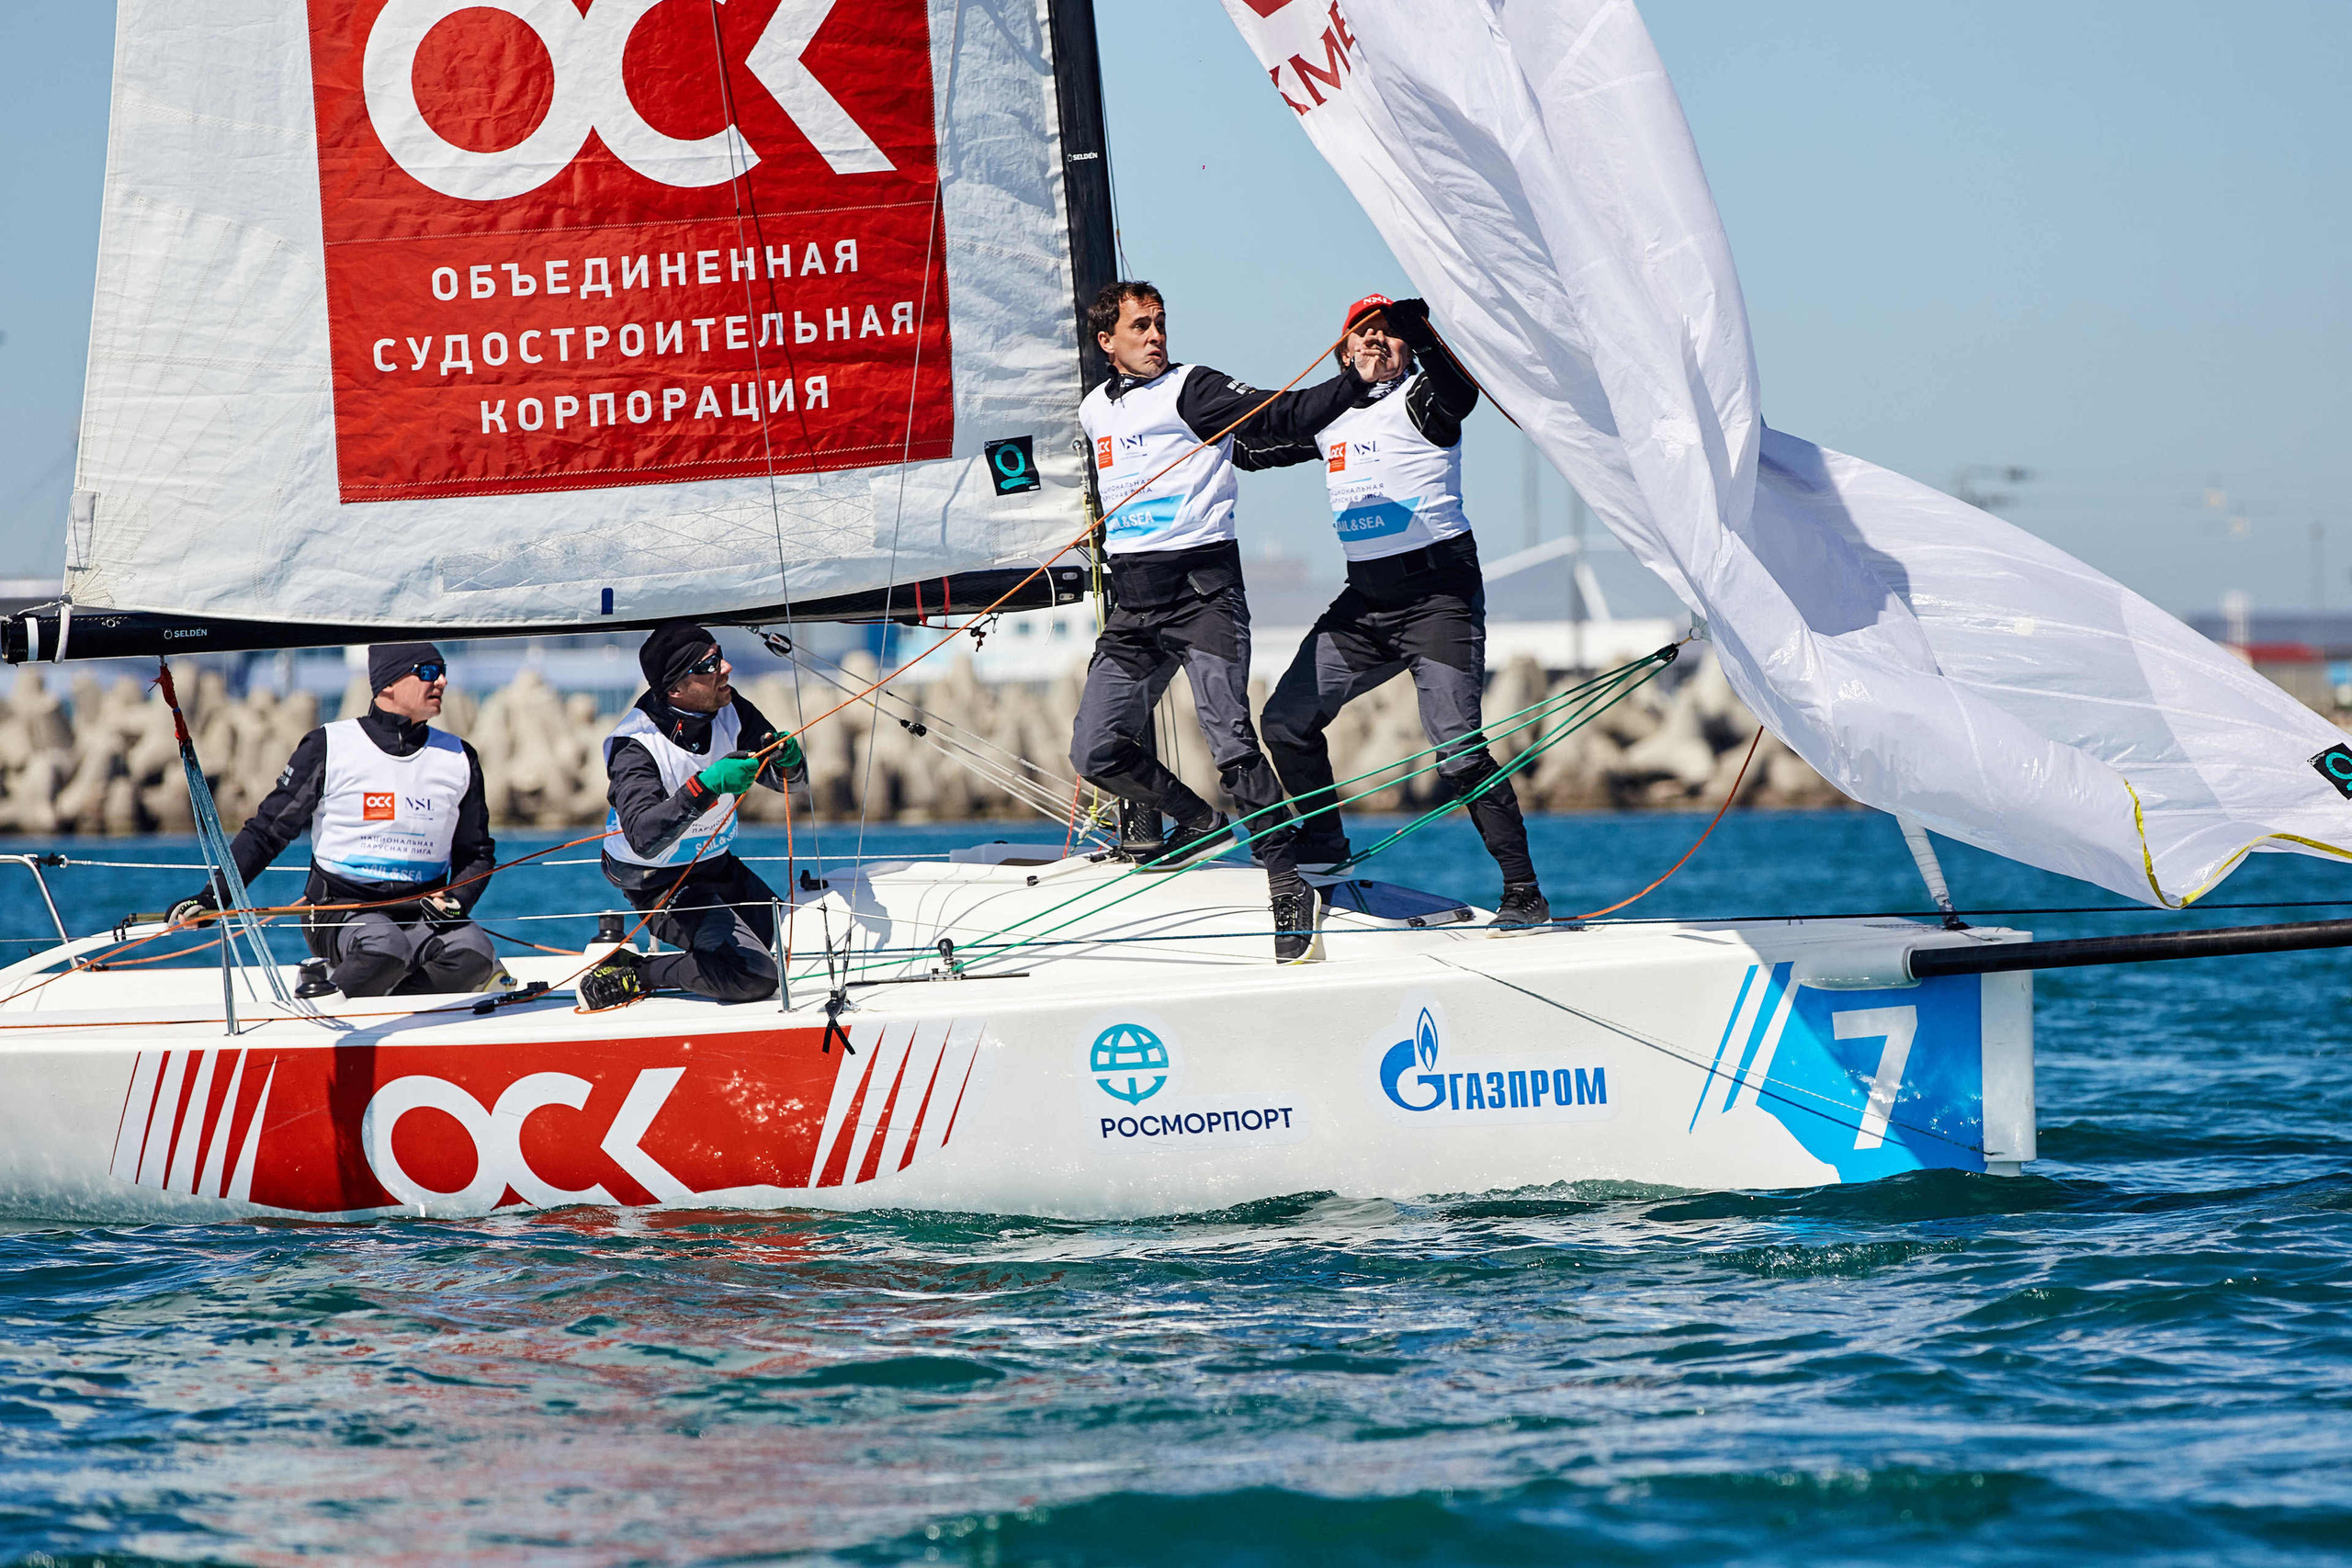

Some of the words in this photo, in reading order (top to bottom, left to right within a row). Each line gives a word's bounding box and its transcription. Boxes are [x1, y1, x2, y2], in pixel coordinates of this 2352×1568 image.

[363, 0, 898, 200] ОСК
[430, 238, 859, 301] ОБЪЕДИНЕННАЯ
[372, 300, 916, 376] СУДОСТРОИТЕЛЬНАЯ
[480, 375, 830, 434] КОРПОРАЦИЯ
[174, 627, 208, 637] SELDÉN
[366, 796, 392, 807] ОСК
[1449, 1066, 1607, 1111] ГАЗПРОМ
[1832, 1004, 1918, 1150] 7
[361, 1066, 695, 1209] ОСК
[1101, 1107, 1293, 1138] РОСМОРПОРТ
